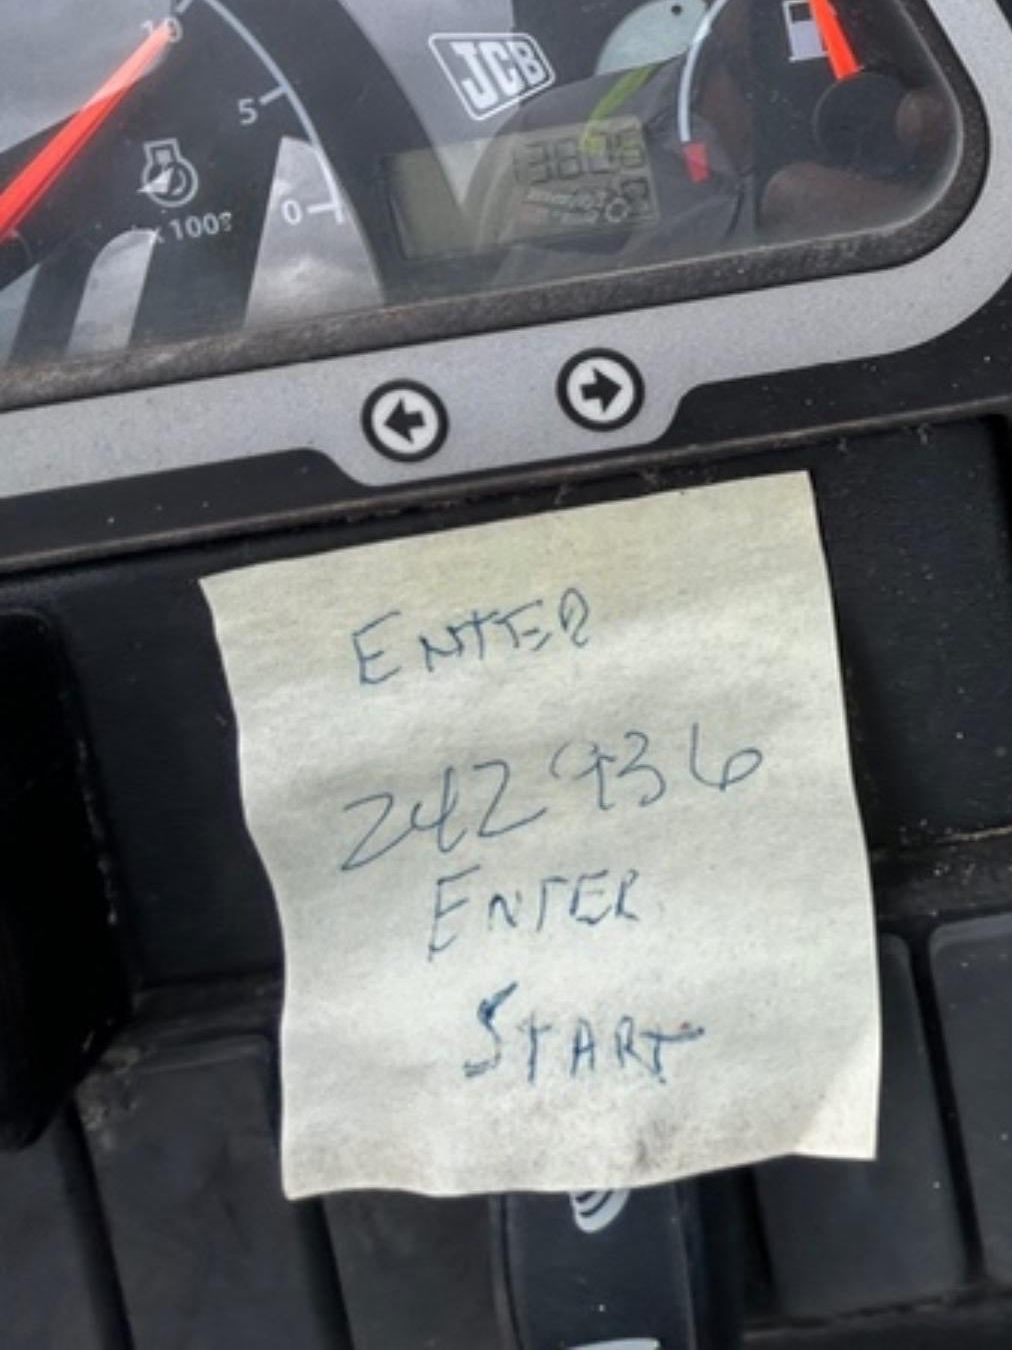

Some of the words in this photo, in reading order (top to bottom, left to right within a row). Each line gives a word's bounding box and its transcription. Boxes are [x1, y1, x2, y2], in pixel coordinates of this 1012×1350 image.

[236, 98, 259, 126] 5
[449, 40, 546, 109] JCB
[280, 199, 303, 226] 0
[352, 587, 591, 685] ENTER
[428, 863, 640, 963] ENTER
[462, 980, 706, 1085] START
